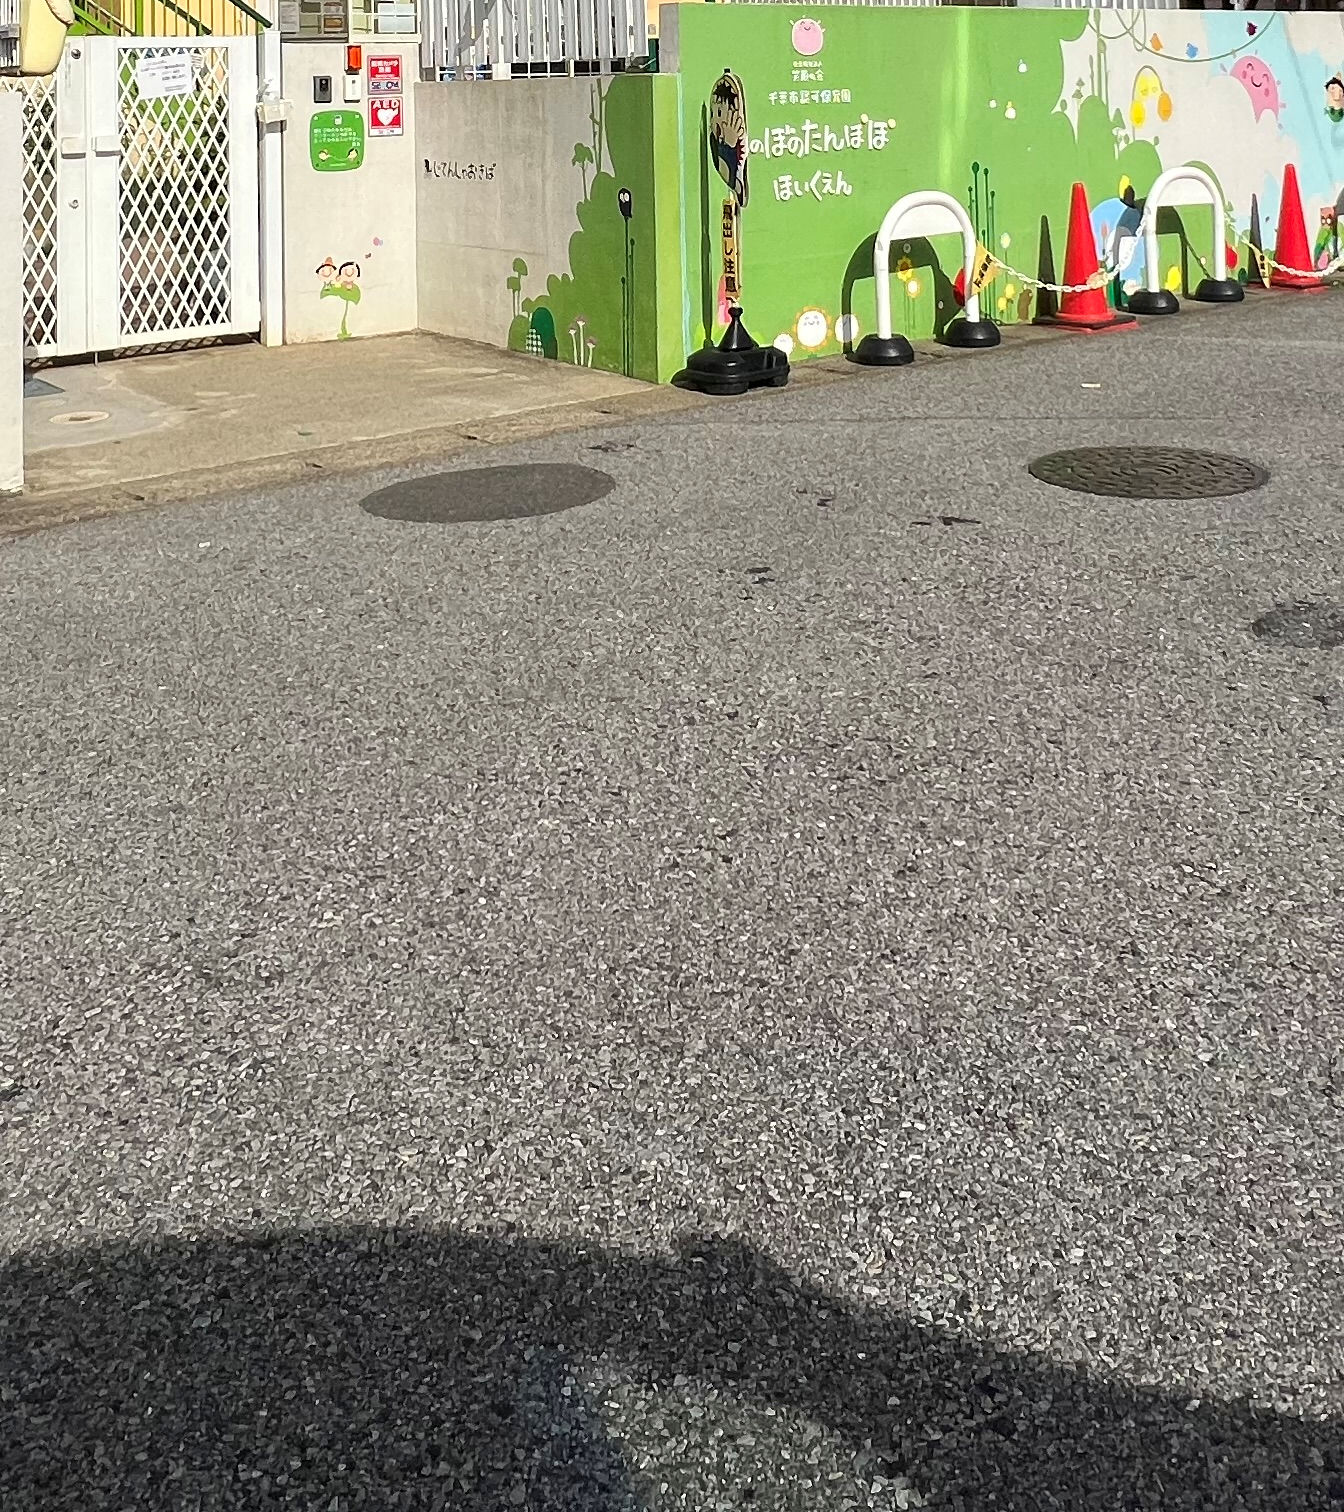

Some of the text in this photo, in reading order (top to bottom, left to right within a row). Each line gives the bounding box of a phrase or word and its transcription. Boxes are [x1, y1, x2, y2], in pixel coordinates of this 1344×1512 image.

[372, 99, 400, 109] AED
[746, 113, 897, 159] のぼのたんぽぽ
[772, 169, 853, 202] ほいくえん
